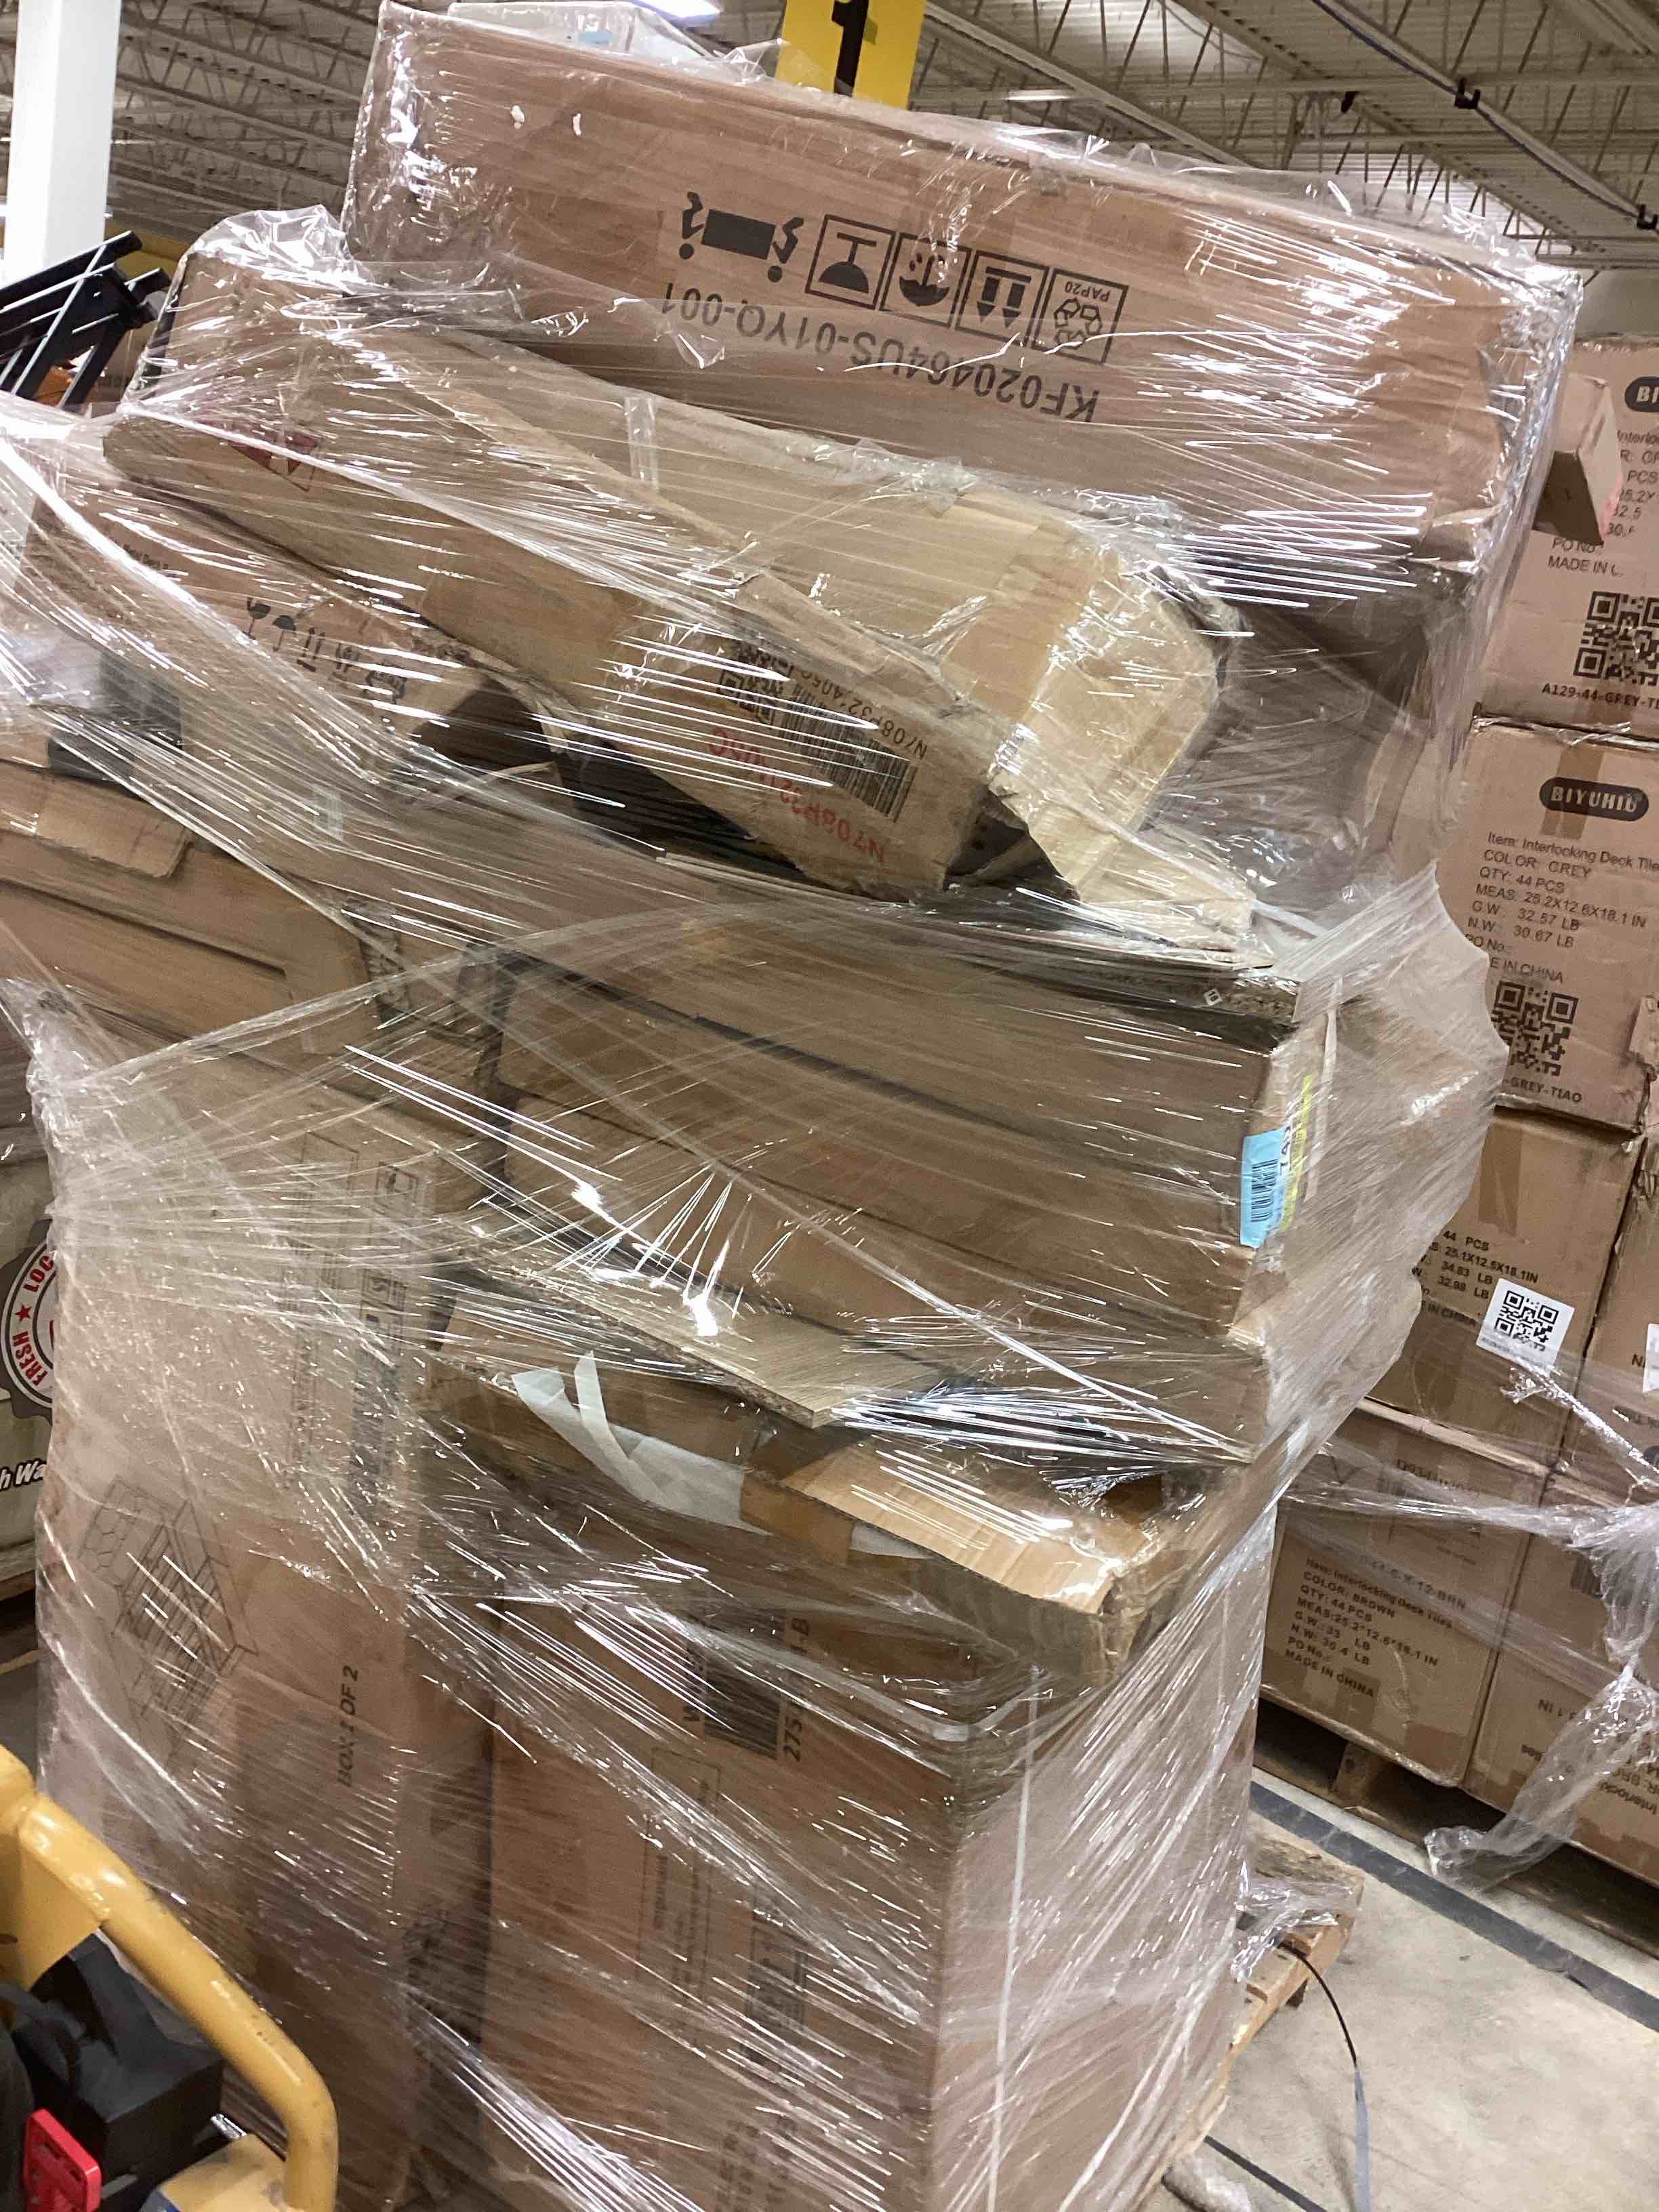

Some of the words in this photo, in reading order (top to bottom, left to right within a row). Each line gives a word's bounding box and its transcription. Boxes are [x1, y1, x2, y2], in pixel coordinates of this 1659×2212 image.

[1065, 281, 1110, 302] PAP20
[1548, 555, 1591, 571] MADE
[1593, 561, 1609, 574] IN
[1523, 838, 1597, 863] Interlocking
[1599, 851, 1633, 868] Deck
[1516, 874, 1532, 886] 44
[1536, 878, 1566, 894] PCS
[1561, 917, 1580, 931] LB
[1557, 936, 1575, 948] LB
[1520, 963, 1563, 984] CHINA
[1465, 1237, 1490, 1251] PCS
[1477, 1272, 1494, 1285] LB
[1473, 1288, 1490, 1300] LB
[12, 1330, 48, 1386] FRESH
[1353, 1593, 1396, 1618] BROWN
[1355, 1652, 1370, 1665] LB
[342, 1665, 359, 1681] 2
[1336, 1673, 1374, 1698] CHINA
[340, 1683, 356, 1716] OF
